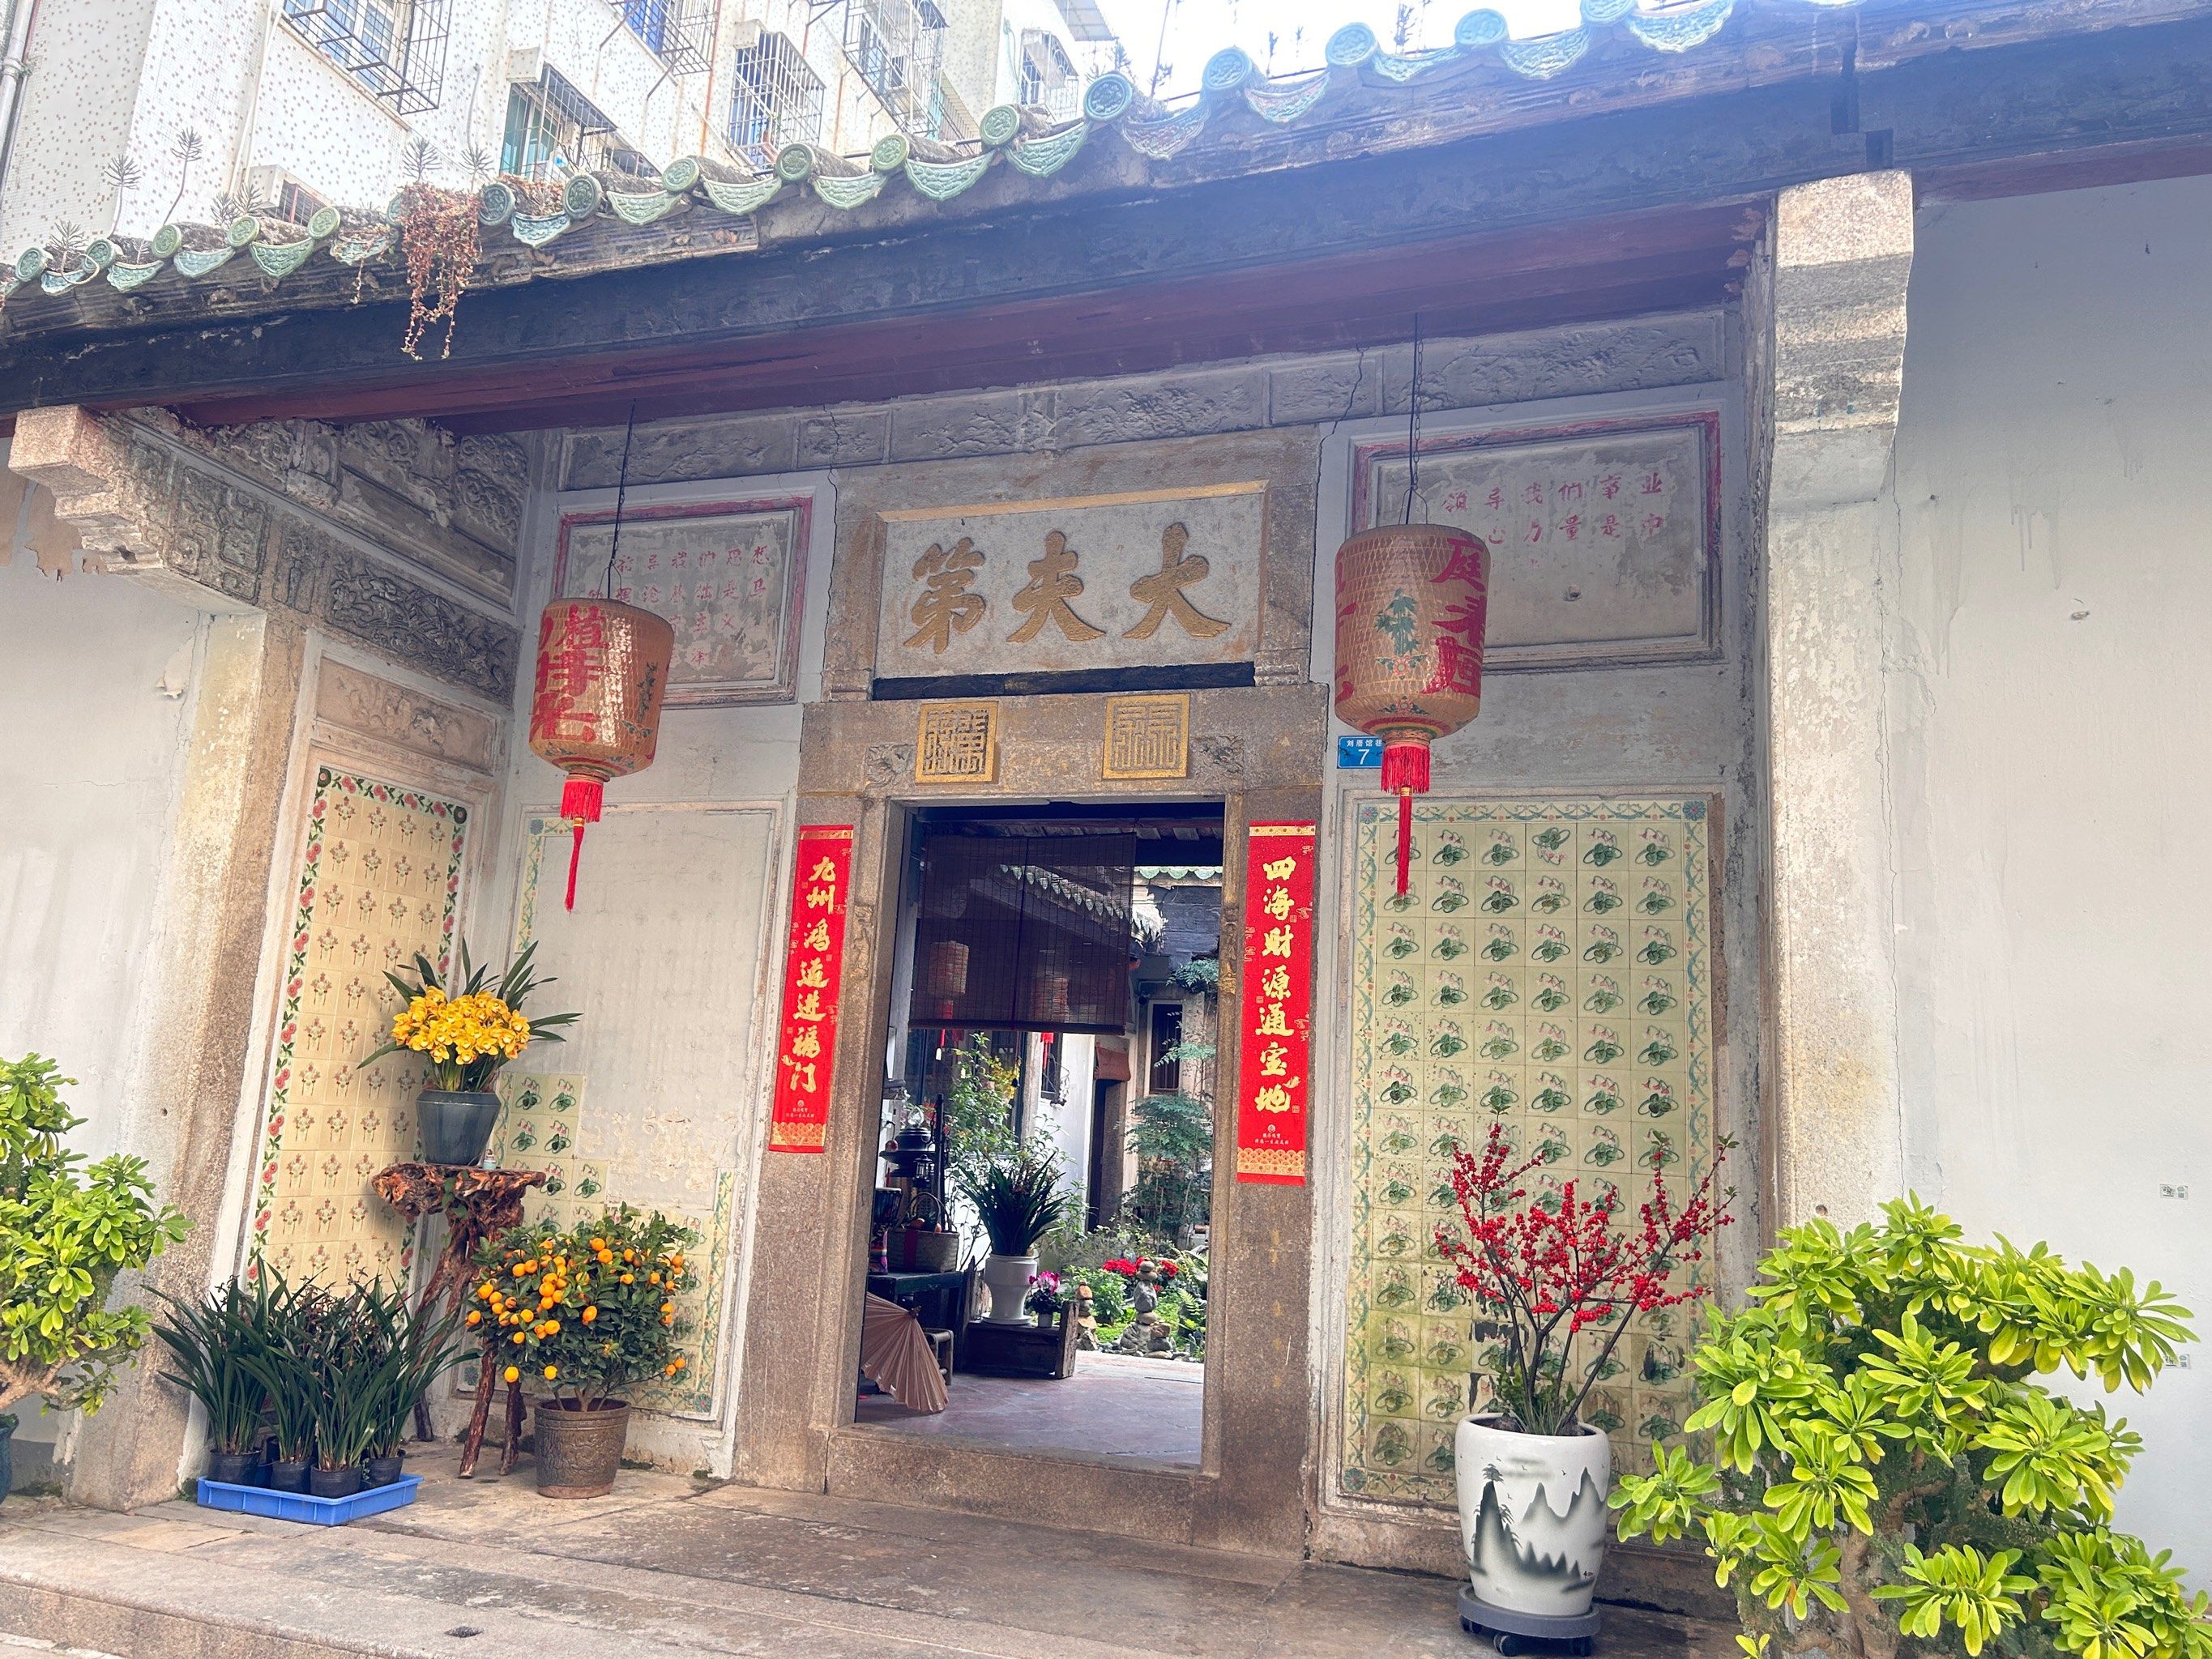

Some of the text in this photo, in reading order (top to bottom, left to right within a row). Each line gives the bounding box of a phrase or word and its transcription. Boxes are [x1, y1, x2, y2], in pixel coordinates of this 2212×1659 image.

[903, 521, 1232, 655] 大夫第
[1358, 748, 1370, 765] 7
[1255, 855, 1301, 1115] 四海财源通宝地
